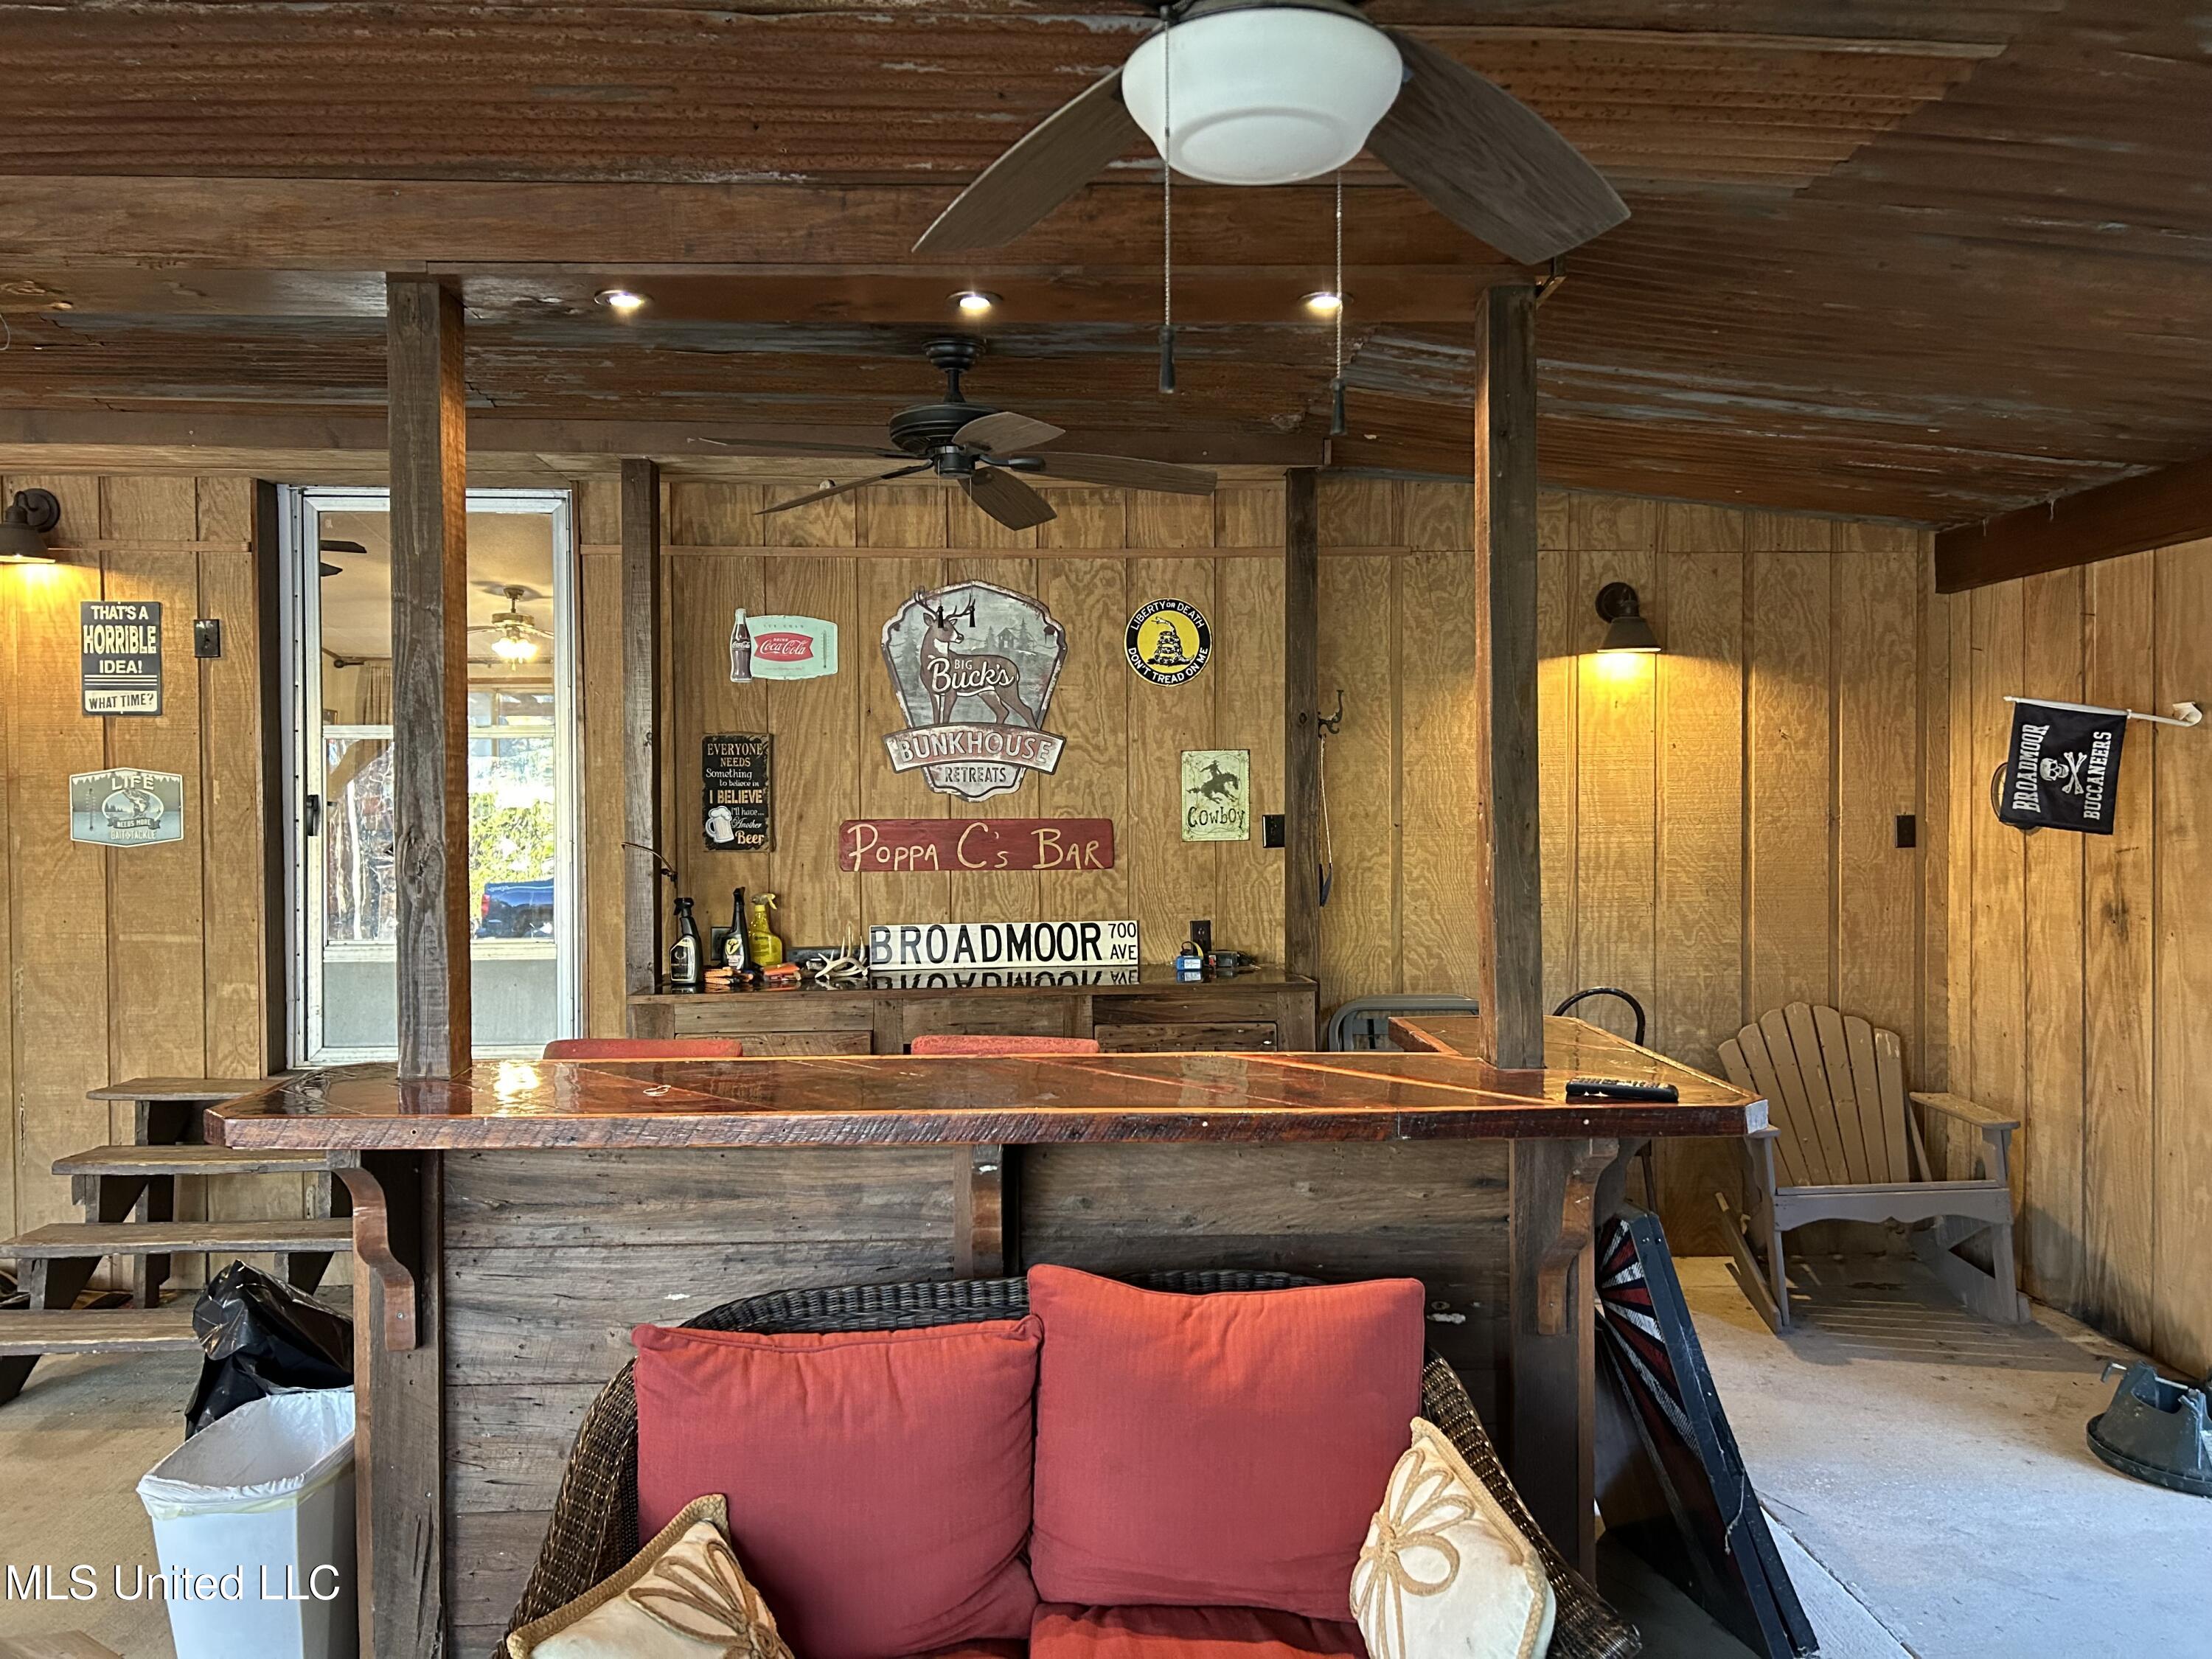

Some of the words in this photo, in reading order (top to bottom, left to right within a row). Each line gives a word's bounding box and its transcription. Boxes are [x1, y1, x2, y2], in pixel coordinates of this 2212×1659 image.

[90, 605, 136, 620] THAT'S
[139, 605, 149, 620] A
[1130, 601, 1166, 630] LIBERTY
[1177, 602, 1205, 628] DEATH
[83, 625, 157, 655] HORRIBLE
[99, 660, 142, 673] IDEA!
[953, 659, 973, 670] BIG
[1128, 647, 1151, 676] DON'T
[1152, 672, 1185, 684] TREAD
[1185, 662, 1200, 676] ON
[1196, 647, 1208, 664] ME
[927, 655, 1014, 693] Buck's
[88, 695, 118, 709] WHAT
[120, 693, 153, 708] TIME?
[707, 742, 763, 756] EVERYONE
[899, 731, 1053, 764] BUNKHOUSE
[720, 757, 751, 768] NEEDS
[2012, 724, 2050, 813] BROADMOOR
[706, 768, 753, 780] Something
[945, 766, 1007, 783] RETREATS
[2083, 731, 2112, 821] BUCCANEERS
[111, 775, 154, 791] LIFE
[709, 790, 713, 804] I
[717, 789, 763, 804] BELIEVE
[731, 816, 762, 829] Another
[734, 830, 765, 846] Beer
[870, 922, 1103, 965] BROADMOOR
[1108, 922, 1137, 938] 700
[1110, 945, 1137, 960] AVE
